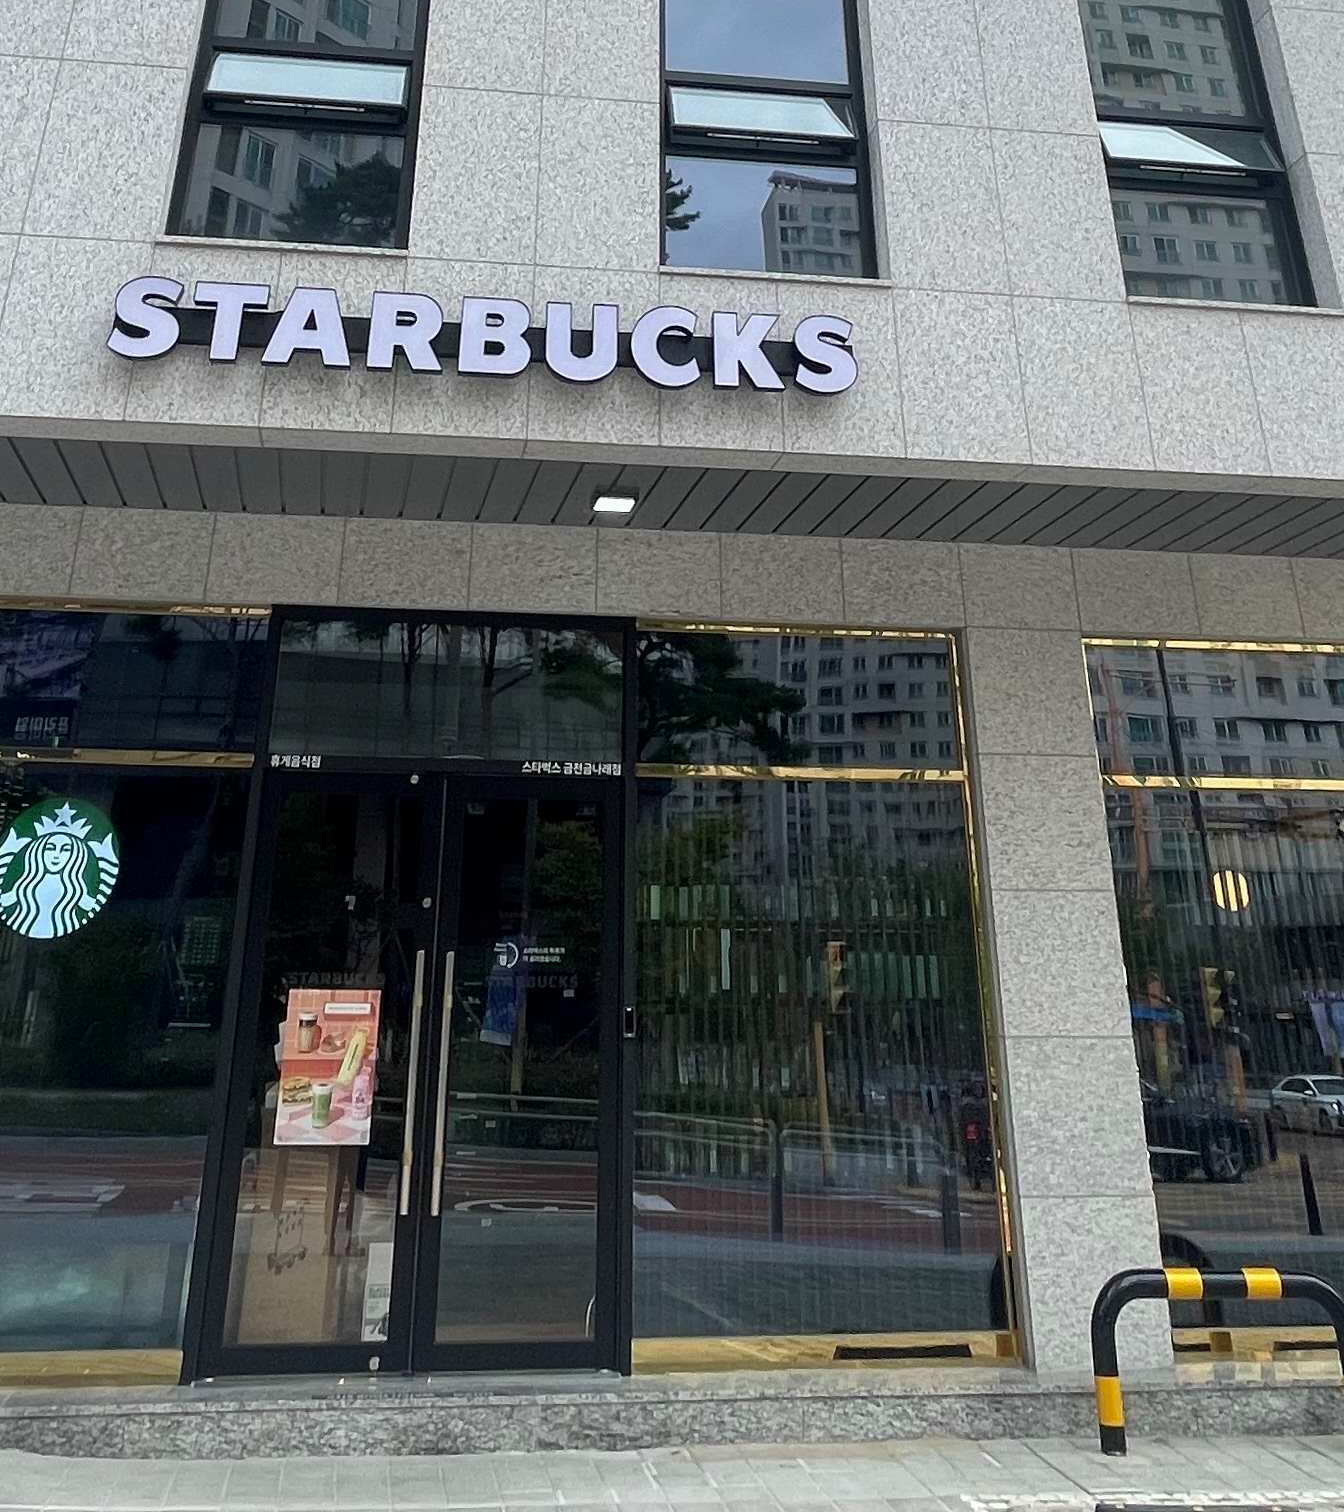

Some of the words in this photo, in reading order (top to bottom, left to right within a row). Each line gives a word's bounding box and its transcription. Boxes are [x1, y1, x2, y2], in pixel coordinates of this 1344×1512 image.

[105, 275, 860, 394] STARBUCKS
[270, 754, 322, 769] 휴게음식점
[521, 760, 561, 774] 스타벅스
[563, 762, 622, 776] 금천금나래점
